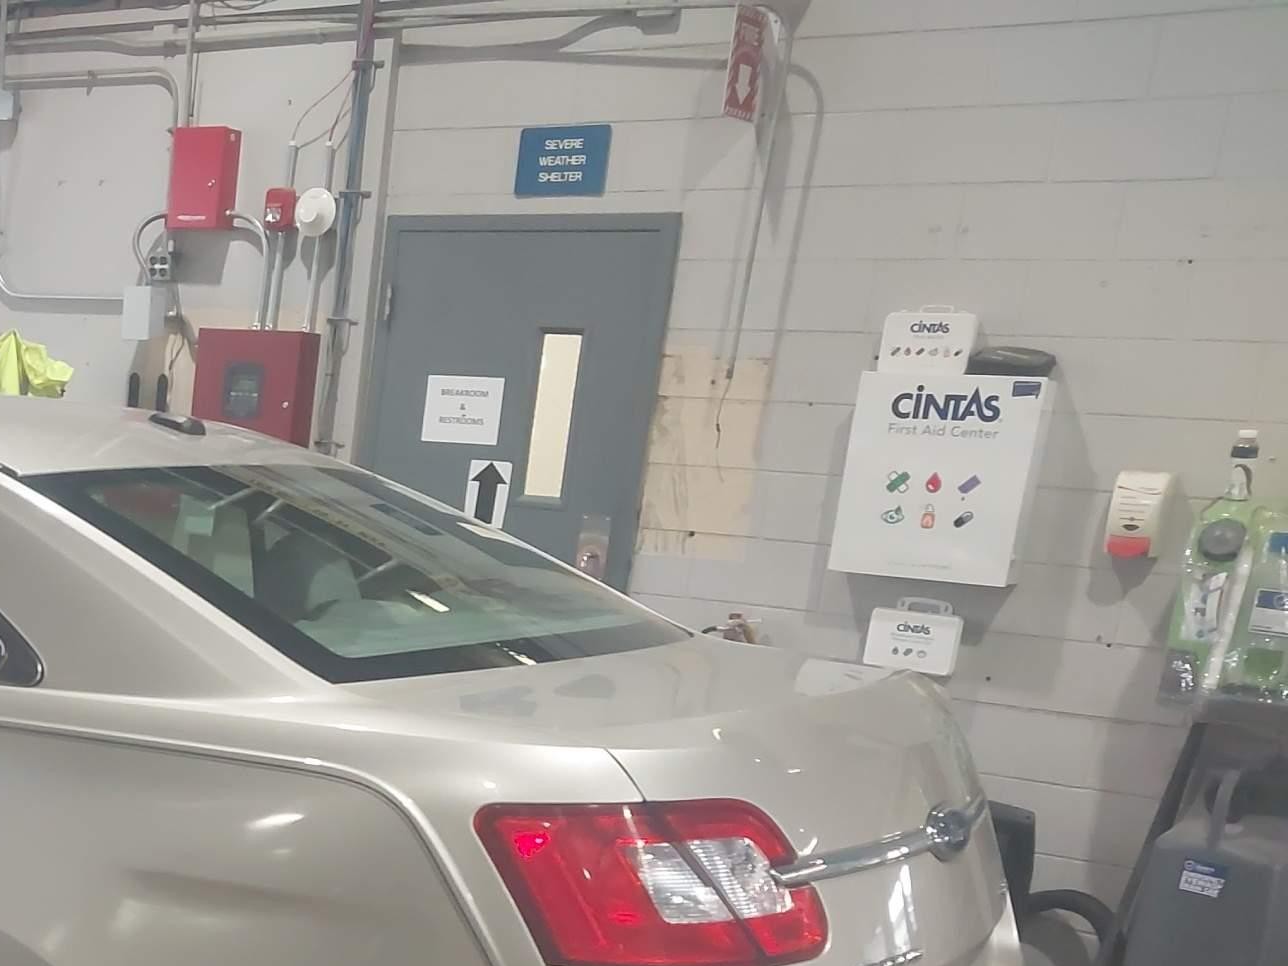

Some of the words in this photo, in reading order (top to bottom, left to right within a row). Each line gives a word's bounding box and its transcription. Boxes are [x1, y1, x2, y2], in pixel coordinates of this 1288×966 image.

[544, 138, 585, 150] SEVERE
[538, 155, 587, 166] WEATHER
[537, 171, 583, 182] SHELTER
[888, 422, 917, 435] First
[921, 424, 946, 437] Aid
[951, 427, 1000, 440] Center
